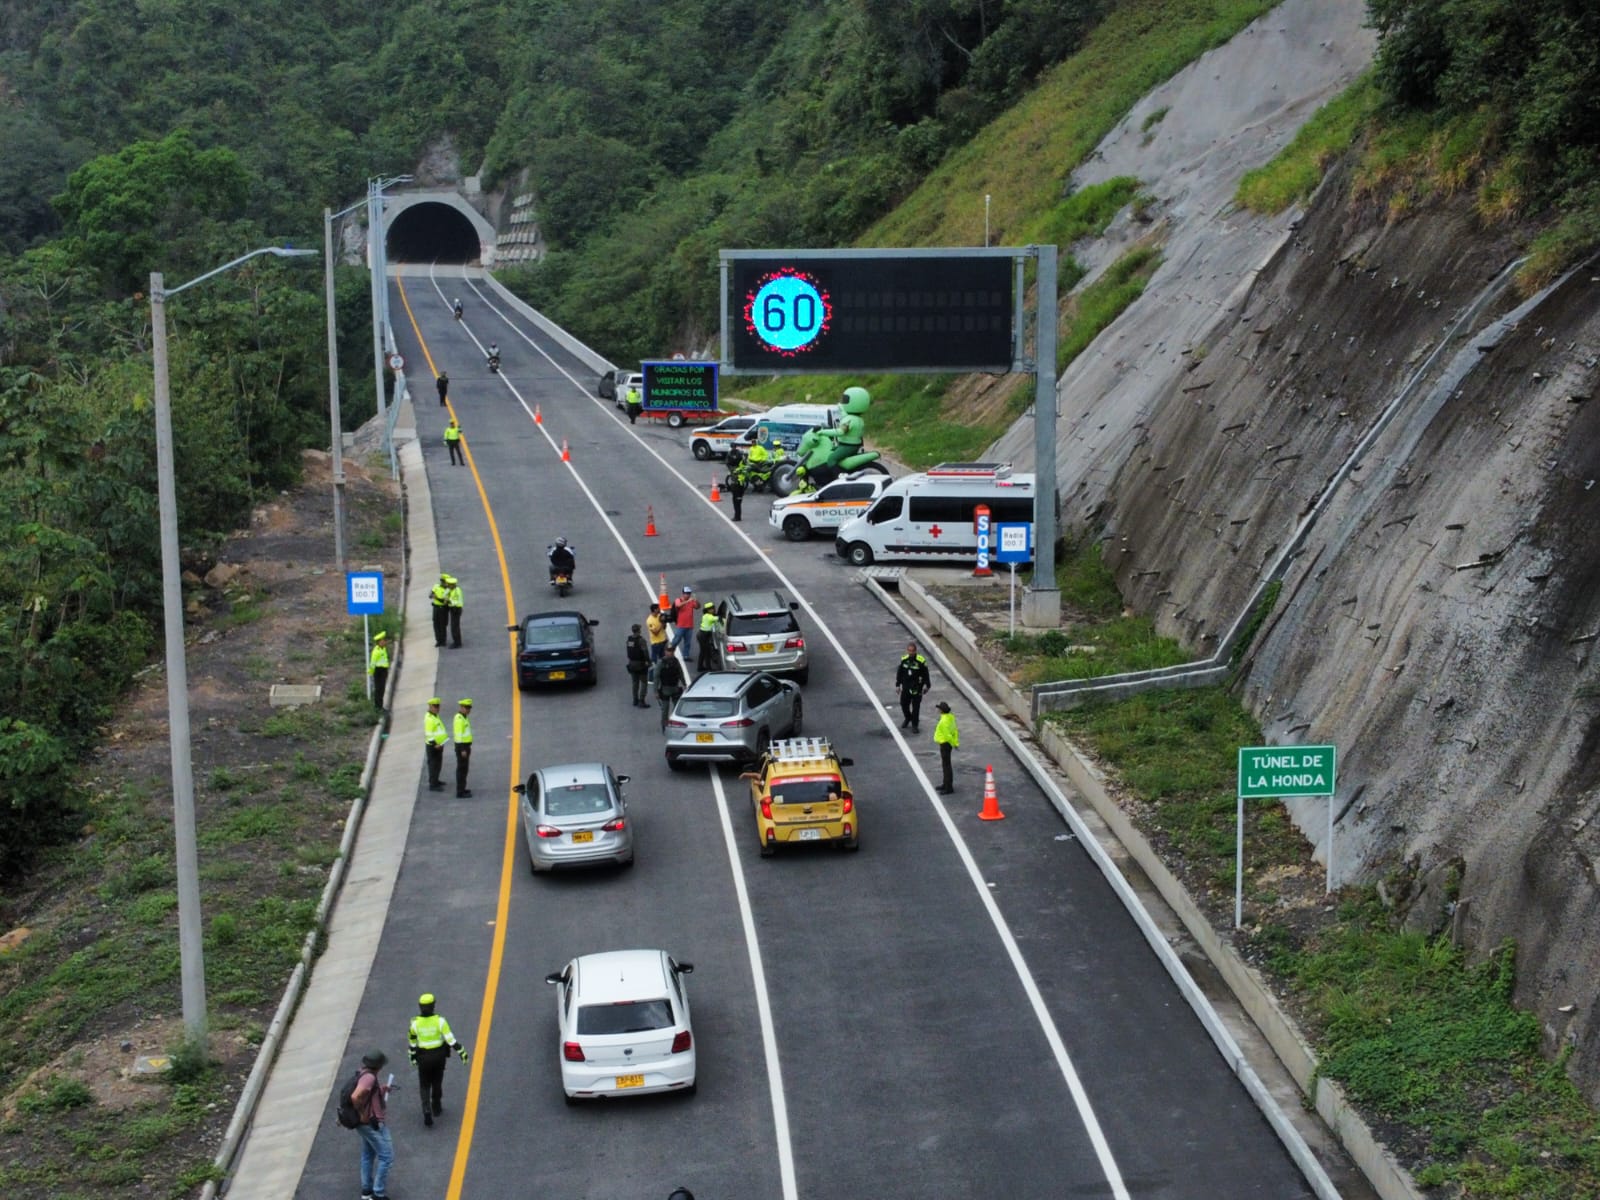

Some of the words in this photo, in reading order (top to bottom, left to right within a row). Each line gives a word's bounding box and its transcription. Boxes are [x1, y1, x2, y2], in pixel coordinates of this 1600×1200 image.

[763, 293, 815, 332] 60
[656, 377, 685, 385] VISITAR
[687, 377, 702, 385] LOS
[693, 388, 707, 396] DEL
[650, 400, 709, 408] DEPARTAMENTO
[1003, 532, 1024, 540] Radio
[977, 515, 989, 568] SOS
[354, 582, 376, 590] Radio
[1252, 754, 1300, 769] TÚNEL
[1302, 755, 1323, 768] DE
[1247, 775, 1268, 788] LA
[1271, 773, 1326, 787] HONDA
